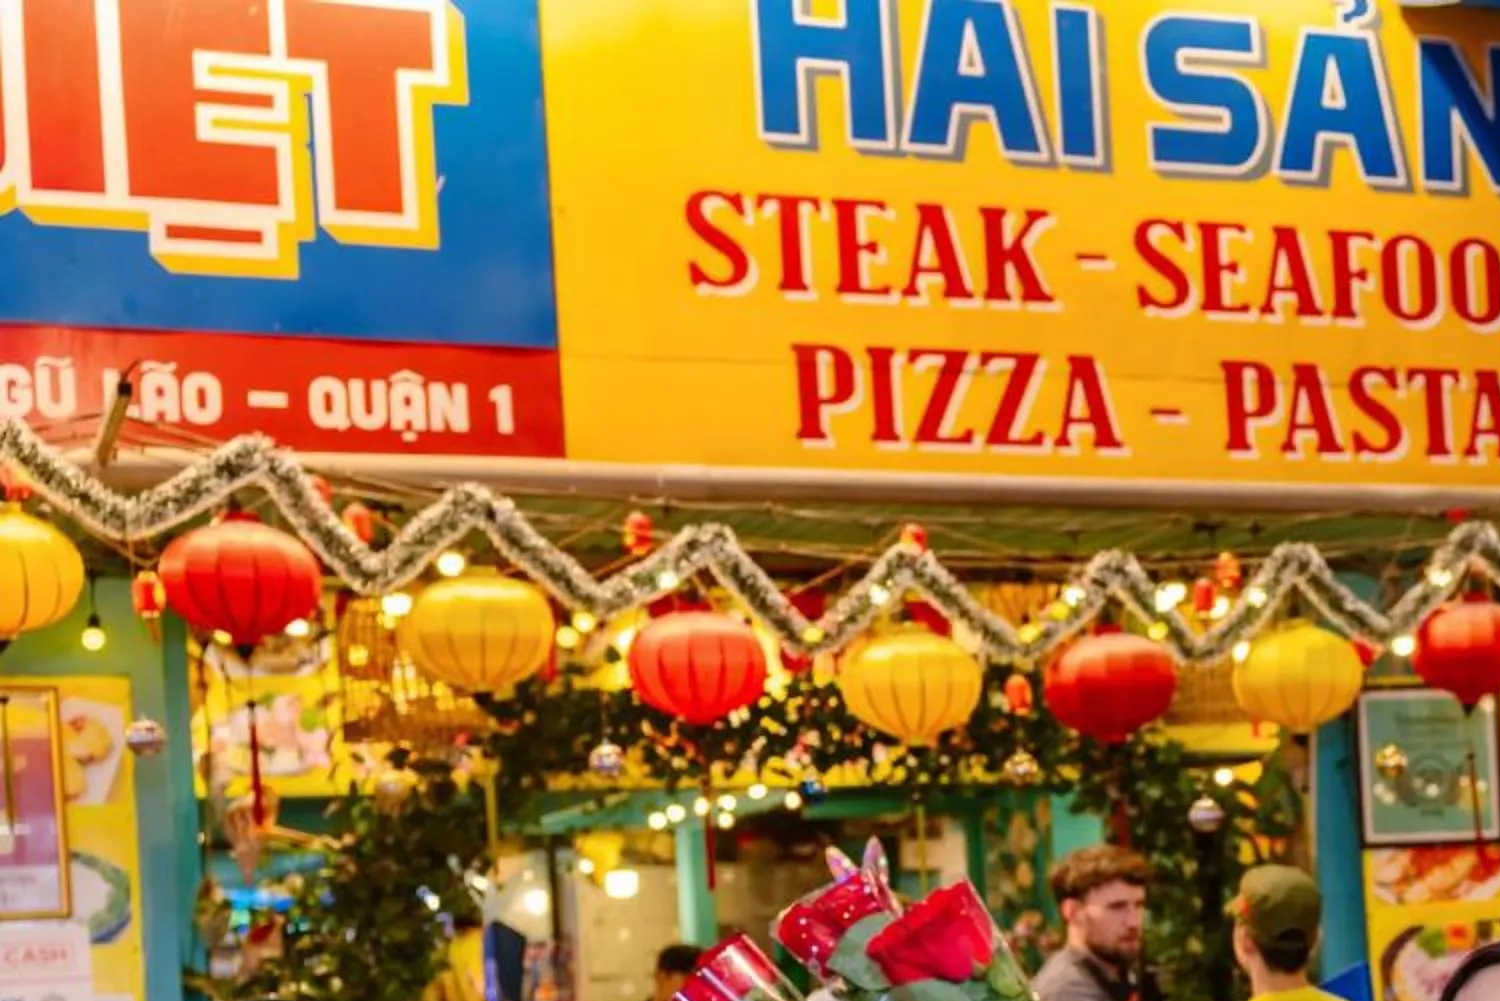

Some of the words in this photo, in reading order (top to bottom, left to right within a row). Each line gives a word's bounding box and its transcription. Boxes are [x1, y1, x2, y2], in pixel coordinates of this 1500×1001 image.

[684, 189, 1061, 314] STEAK
[308, 368, 470, 442] QUẬN
[488, 384, 516, 435] 1
[791, 342, 1131, 457] PIZZA
